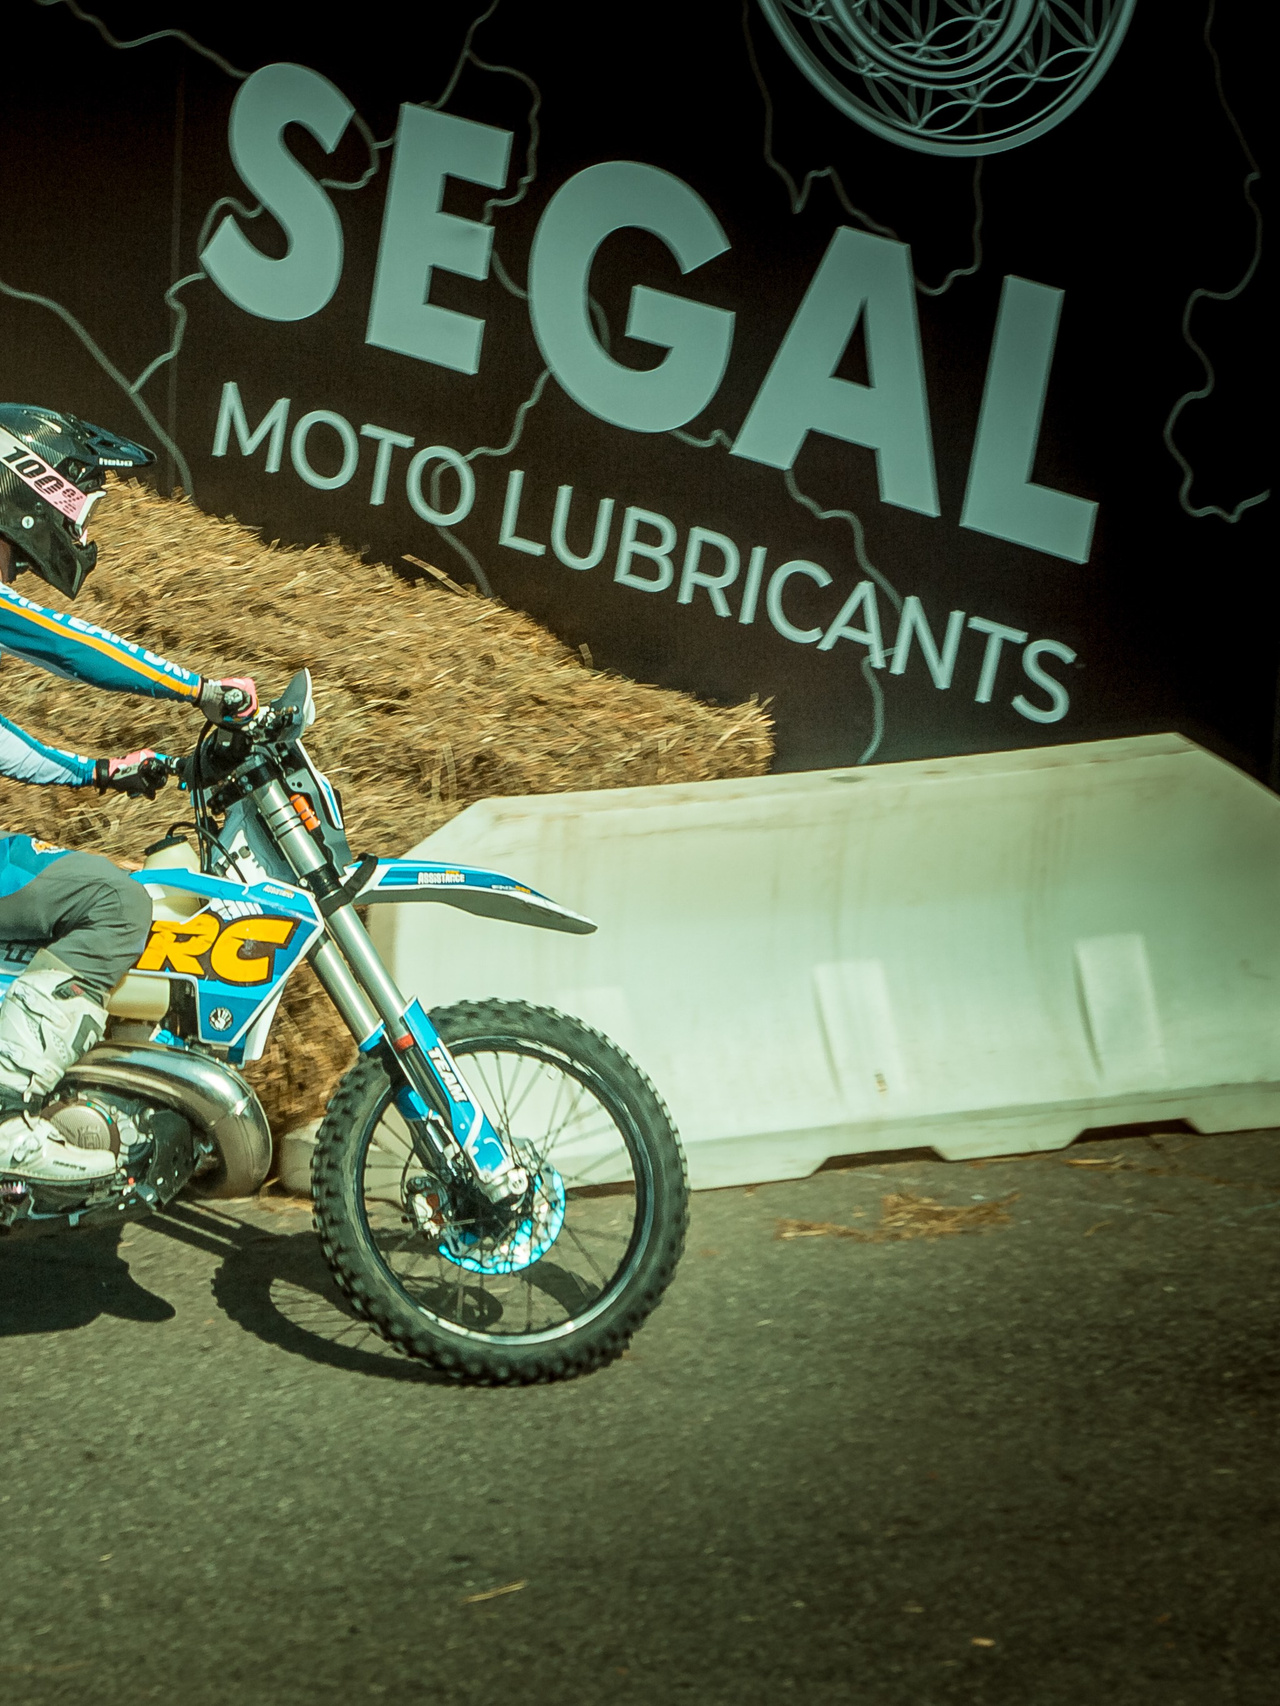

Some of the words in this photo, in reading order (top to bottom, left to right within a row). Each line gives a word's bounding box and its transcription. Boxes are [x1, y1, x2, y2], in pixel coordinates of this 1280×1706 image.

[200, 62, 1100, 565] SEGAL
[211, 381, 476, 527] MOTO
[498, 469, 1078, 725] LUBRICANTS
[427, 1046, 469, 1103] TEAM
